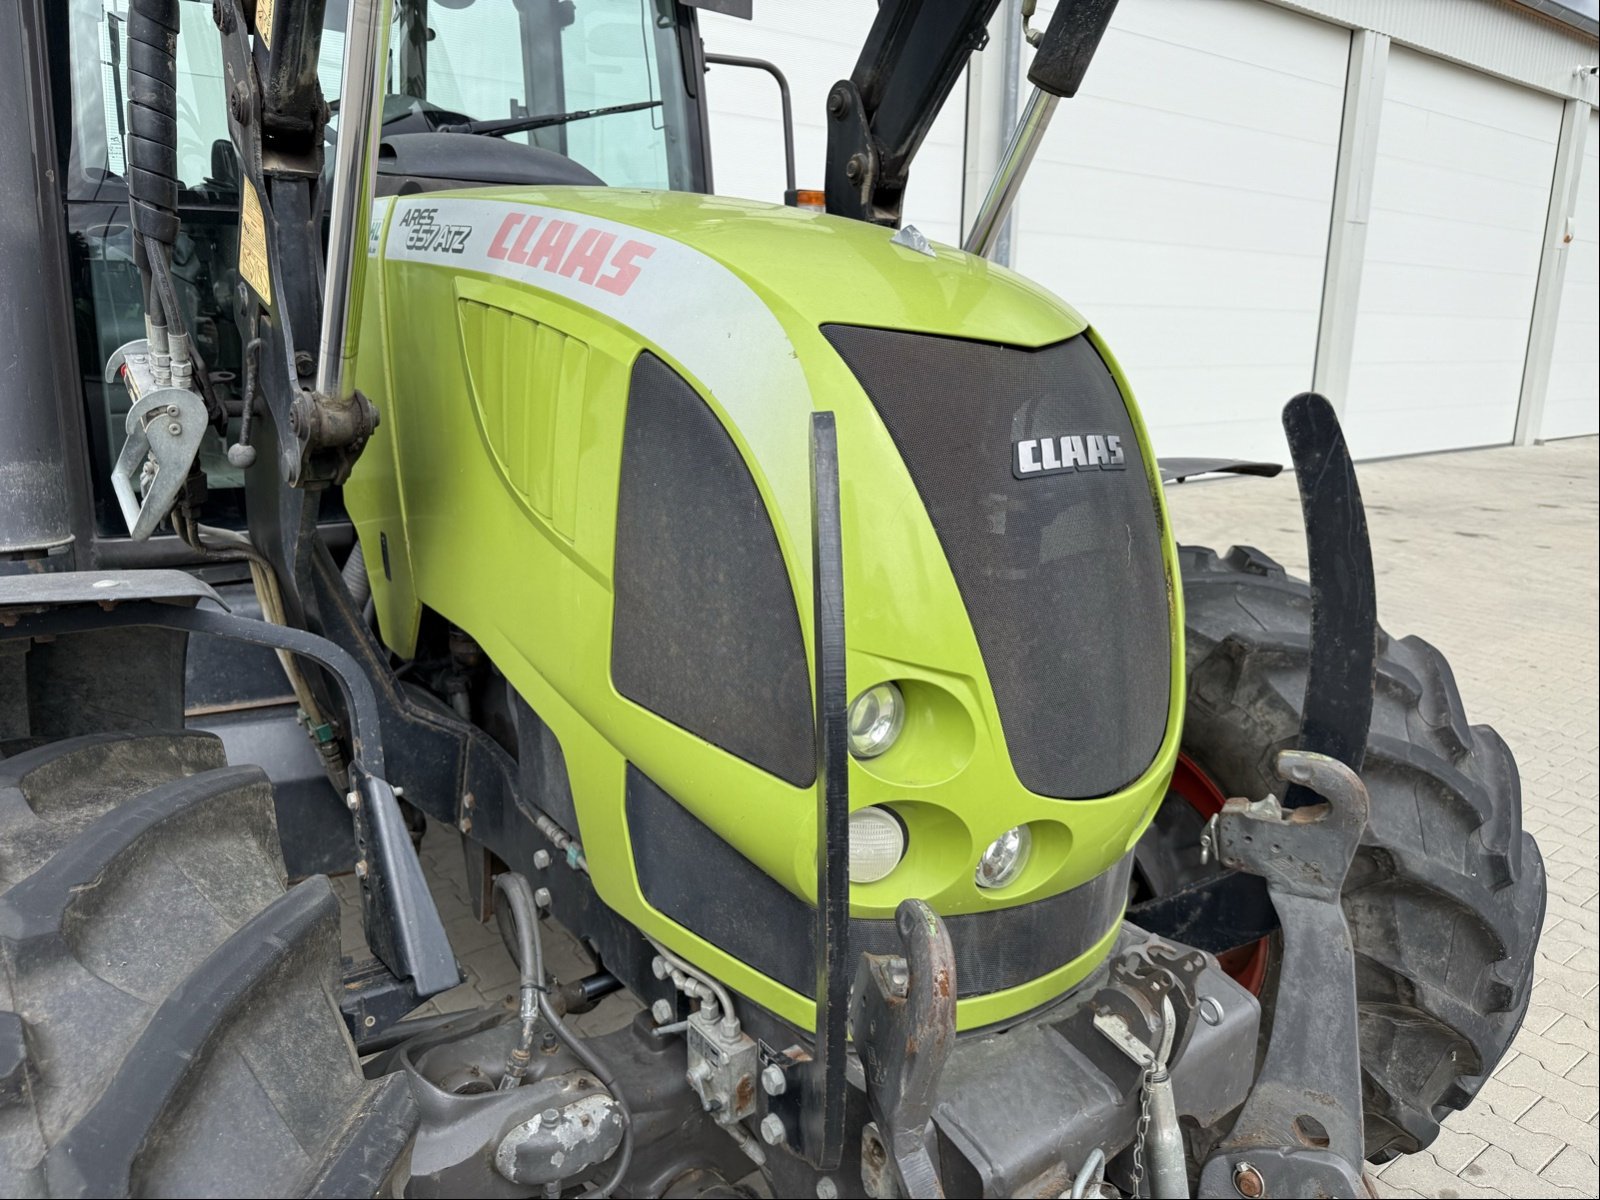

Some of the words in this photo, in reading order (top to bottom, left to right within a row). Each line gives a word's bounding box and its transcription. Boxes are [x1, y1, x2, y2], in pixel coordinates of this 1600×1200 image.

[399, 208, 438, 227] ARES
[487, 213, 654, 296] CLAAS
[1018, 435, 1125, 473] CLAAS
